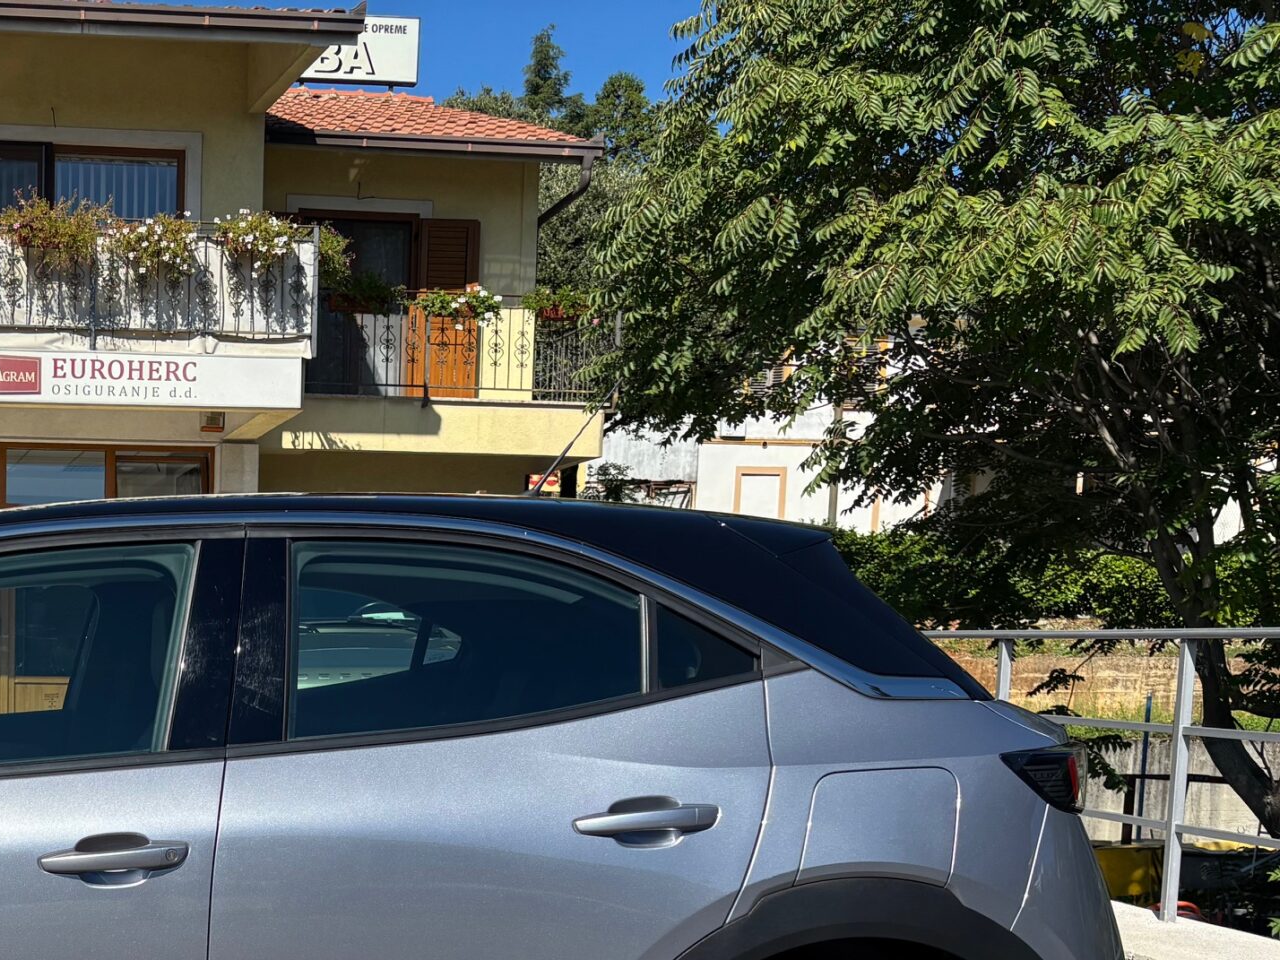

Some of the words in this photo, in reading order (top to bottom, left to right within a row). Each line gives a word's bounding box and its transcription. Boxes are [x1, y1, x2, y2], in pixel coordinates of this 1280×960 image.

[371, 23, 408, 34] OPREME
[51, 357, 198, 382] EUROHERC
[51, 383, 161, 400] OSIGURANJE
[168, 386, 199, 399] d.d.
